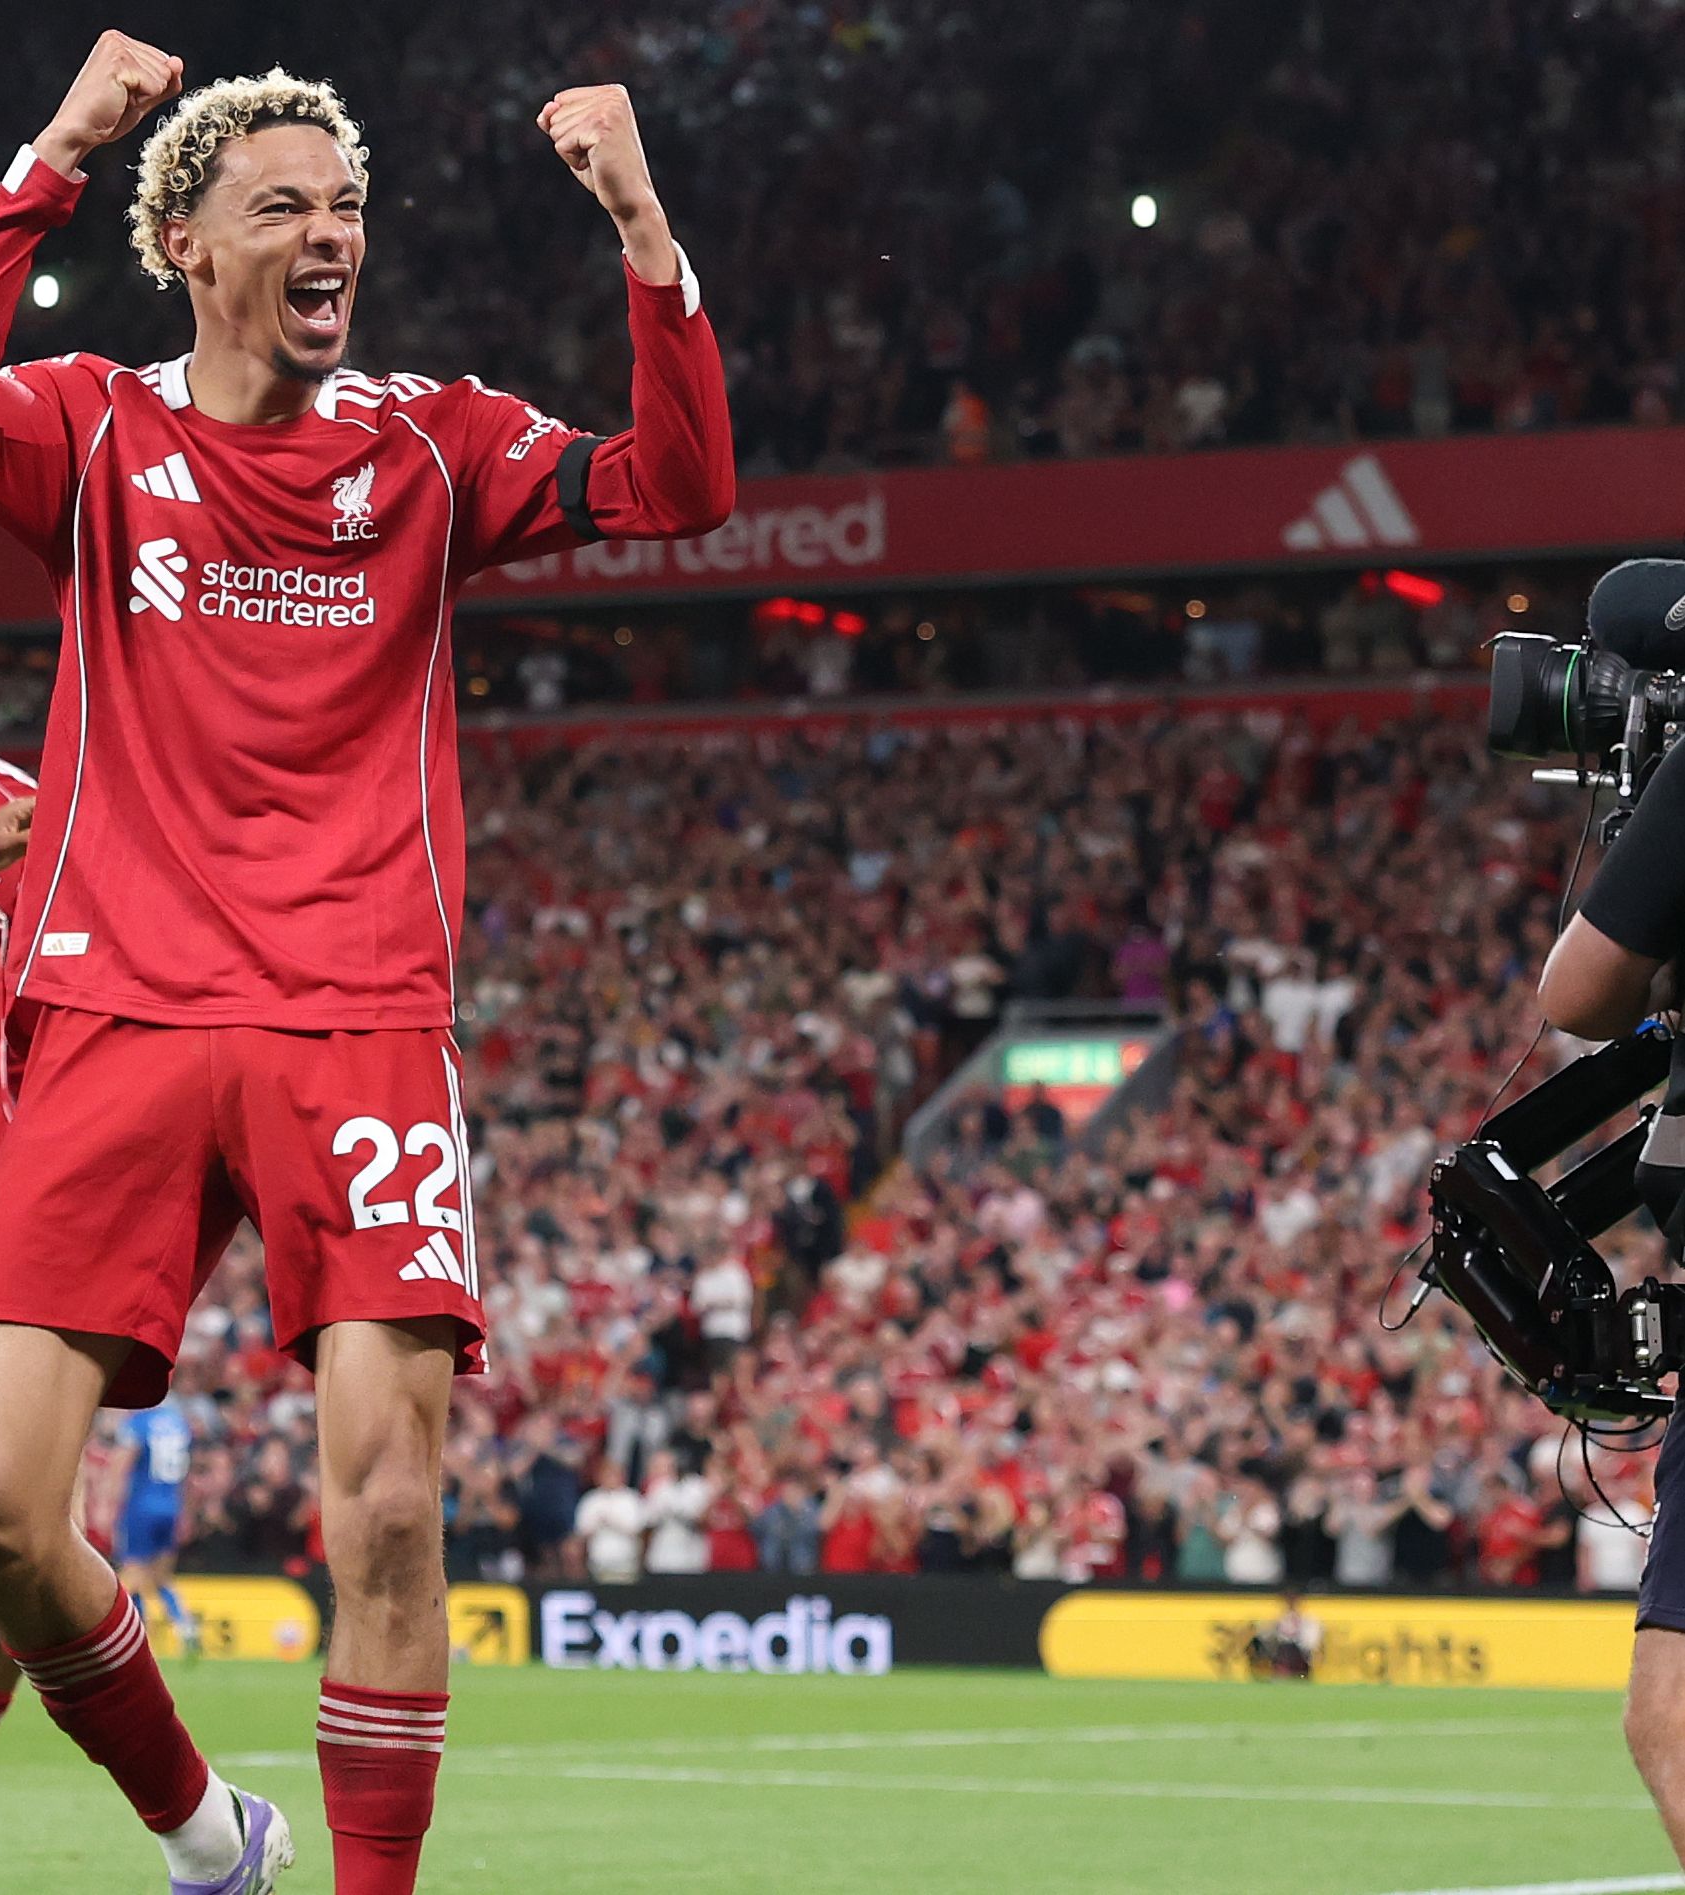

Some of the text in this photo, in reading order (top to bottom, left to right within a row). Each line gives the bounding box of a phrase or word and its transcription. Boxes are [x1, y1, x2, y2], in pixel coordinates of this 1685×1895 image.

[331, 521, 379, 542] L.F.C.
[200, 559, 366, 600] standard
[197, 588, 375, 628] chartered
[332, 1115, 463, 1233] 22
[541, 1590, 893, 1676] Expedia
